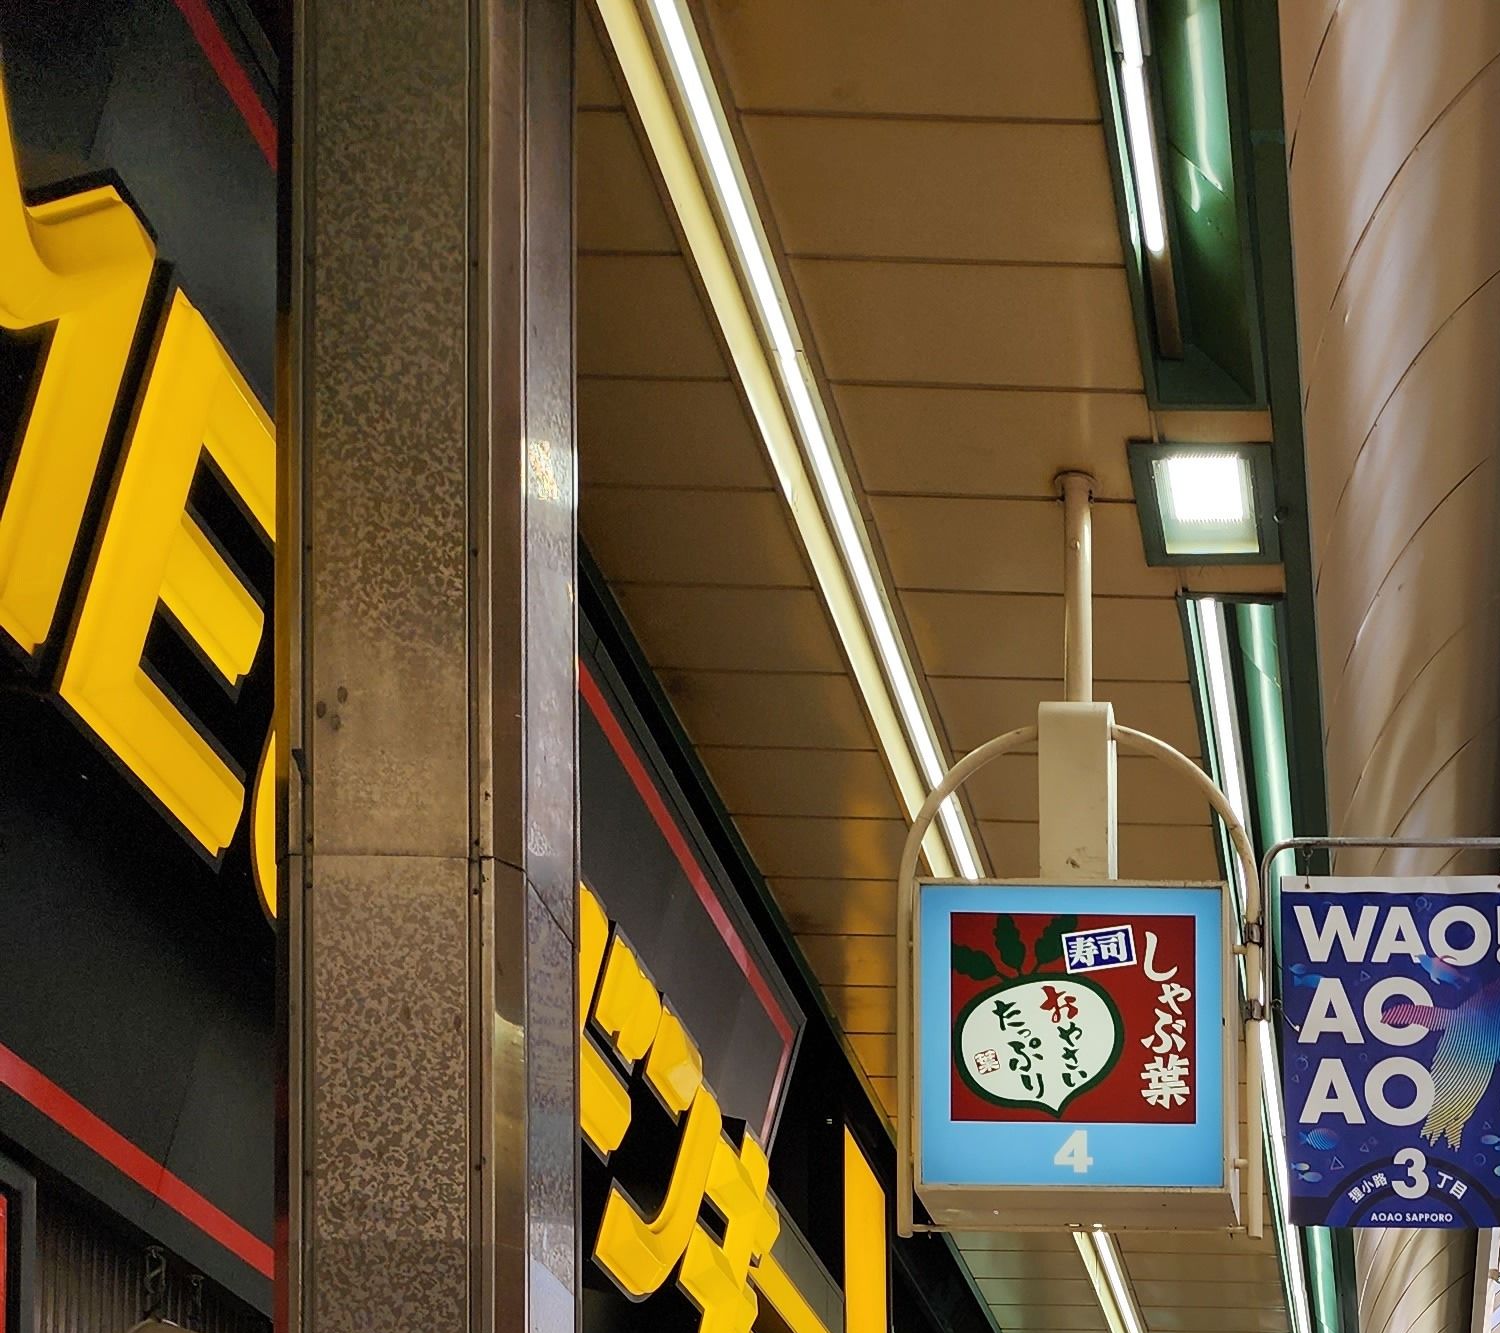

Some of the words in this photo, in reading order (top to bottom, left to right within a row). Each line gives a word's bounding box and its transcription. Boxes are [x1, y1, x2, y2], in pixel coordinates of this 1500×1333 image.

[1067, 930, 1134, 969] 寿司
[992, 998, 1045, 1099] たっぷり
[1039, 984, 1090, 1089] おやさい
[1140, 930, 1192, 1110] しゃぶ葉
[1298, 1056, 1437, 1126] AO
[1053, 1129, 1094, 1173] 4
[1346, 1170, 1389, 1205] 狸小路
[1391, 1146, 1430, 1200] 3
[1435, 1173, 1469, 1201] 丁目
[1370, 1211, 1401, 1223] AOAO
[1404, 1211, 1453, 1223] SAPPORO
